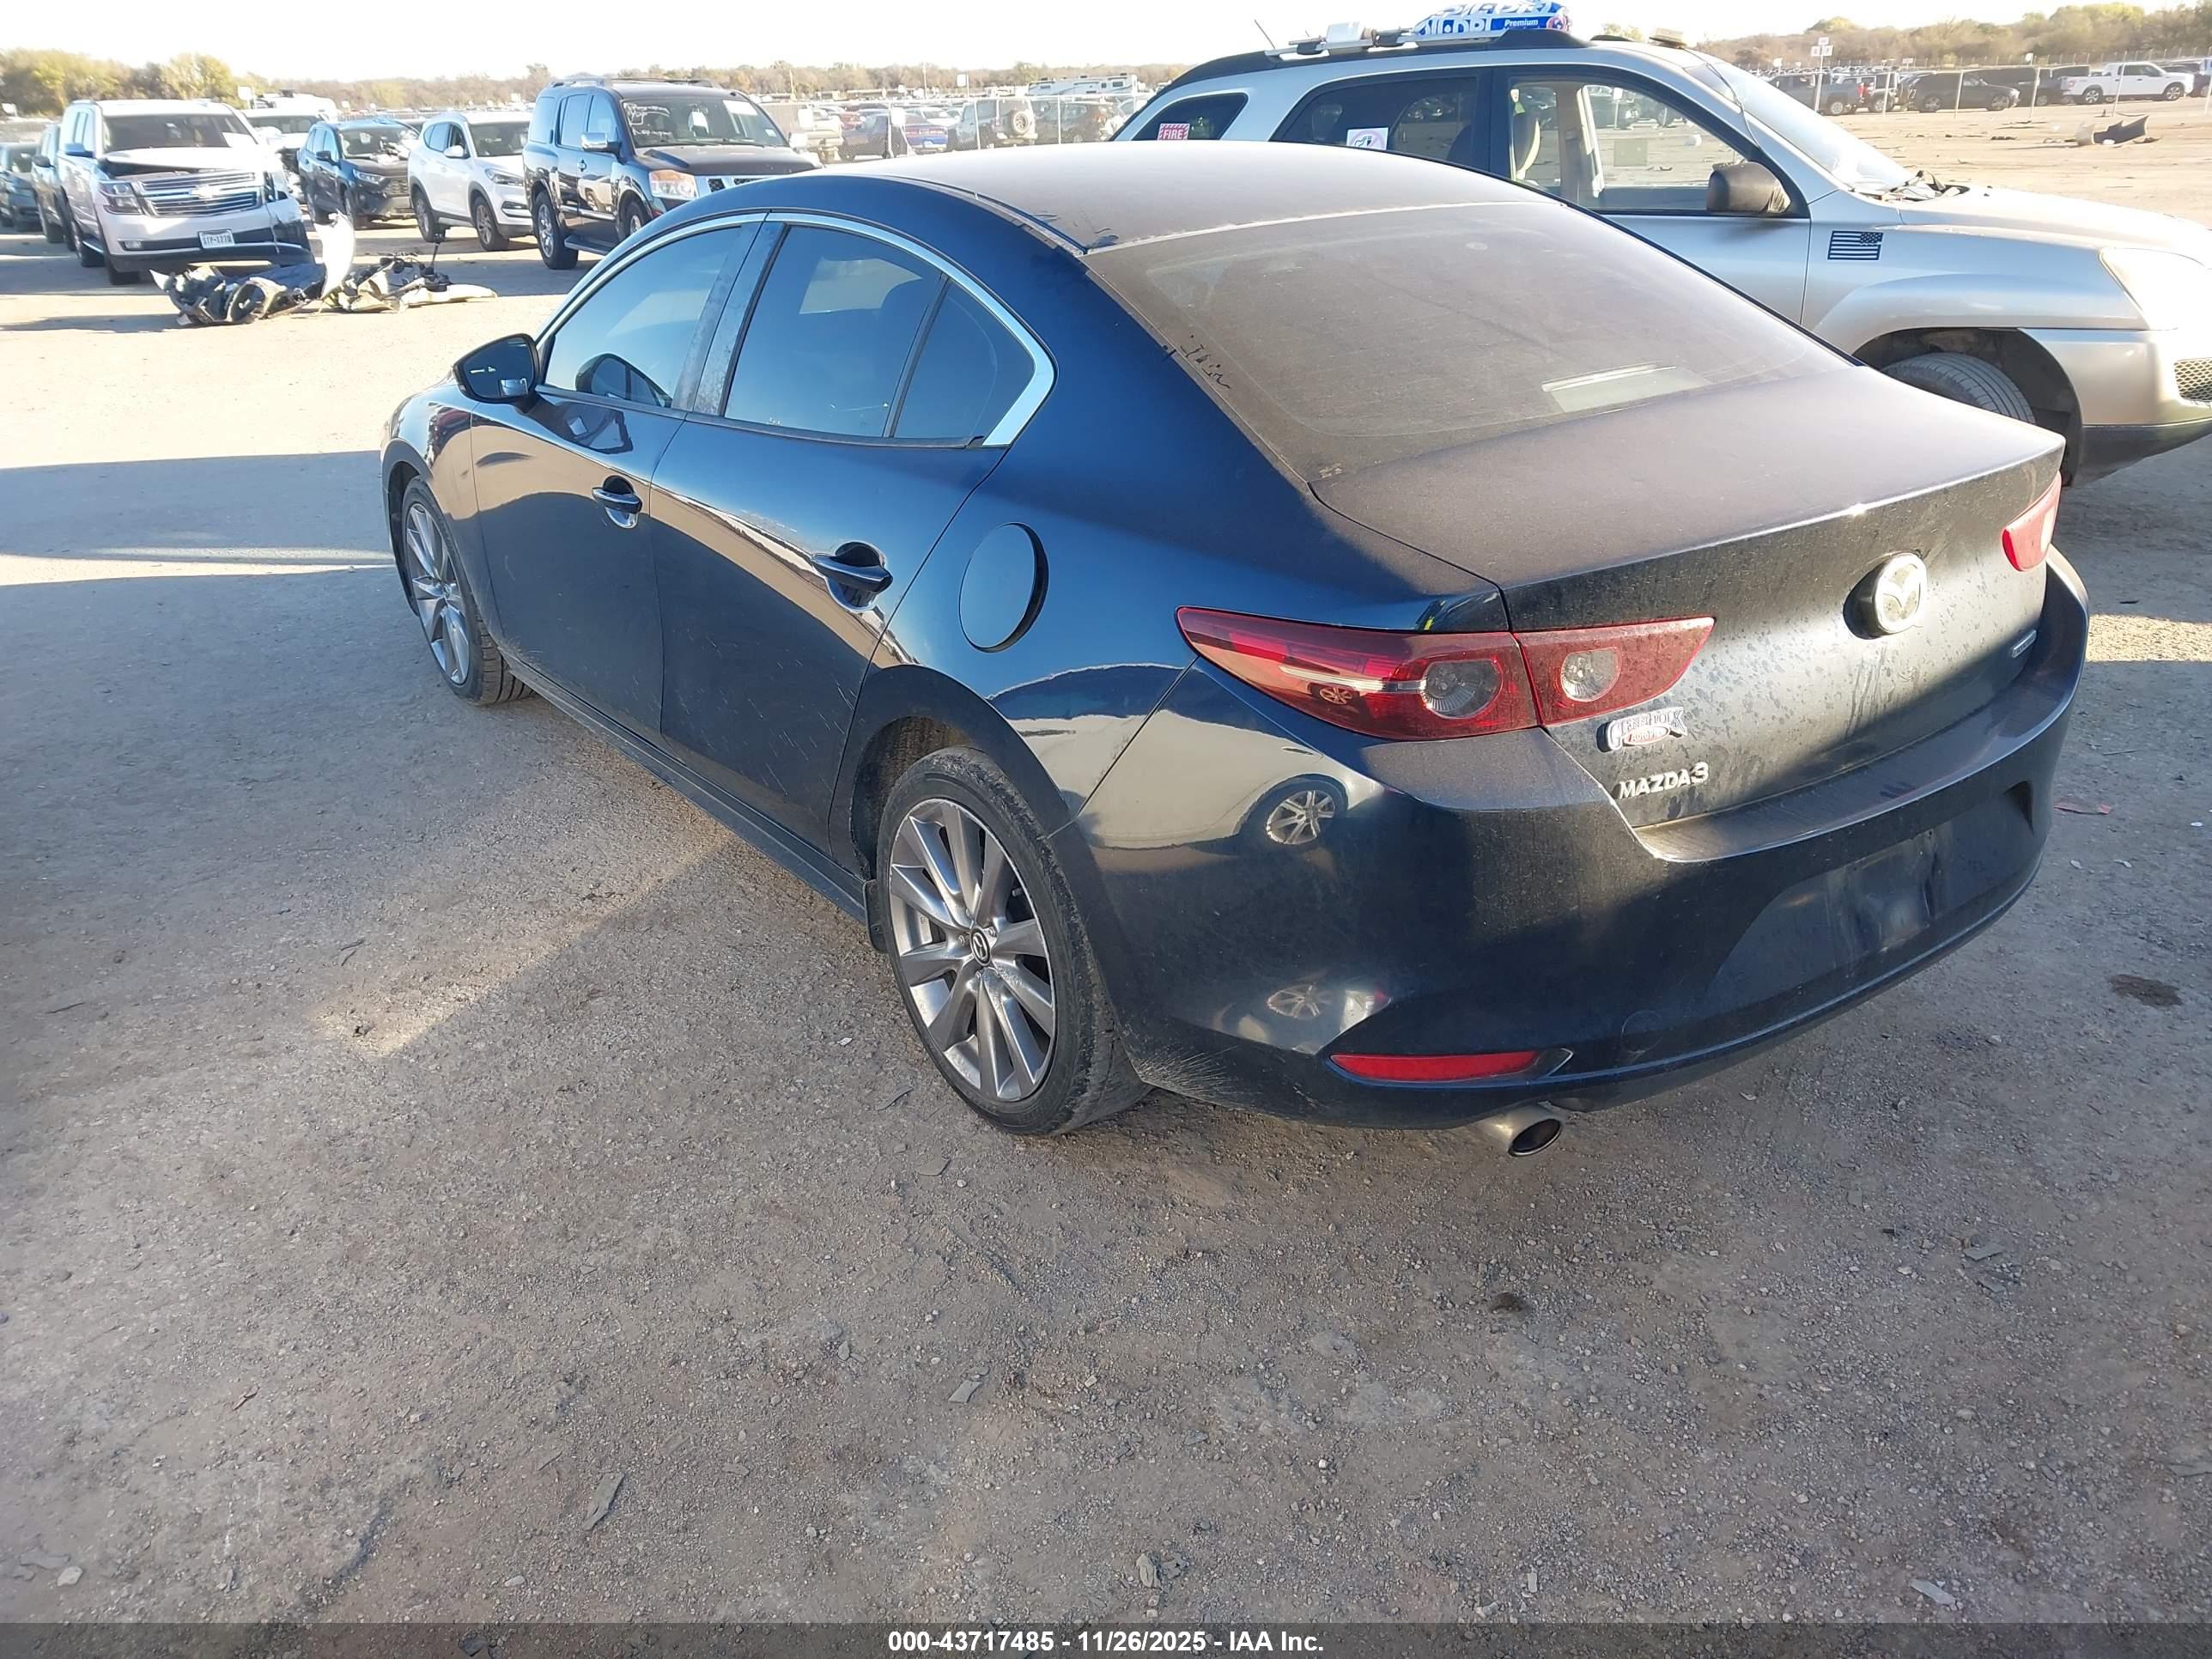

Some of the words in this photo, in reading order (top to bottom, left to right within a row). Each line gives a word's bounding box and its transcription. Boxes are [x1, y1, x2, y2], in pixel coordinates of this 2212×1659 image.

[1504, 18, 1539, 27] Premium
[1163, 129, 1184, 140] FIRE
[1619, 761, 1709, 799] MAZDA3
